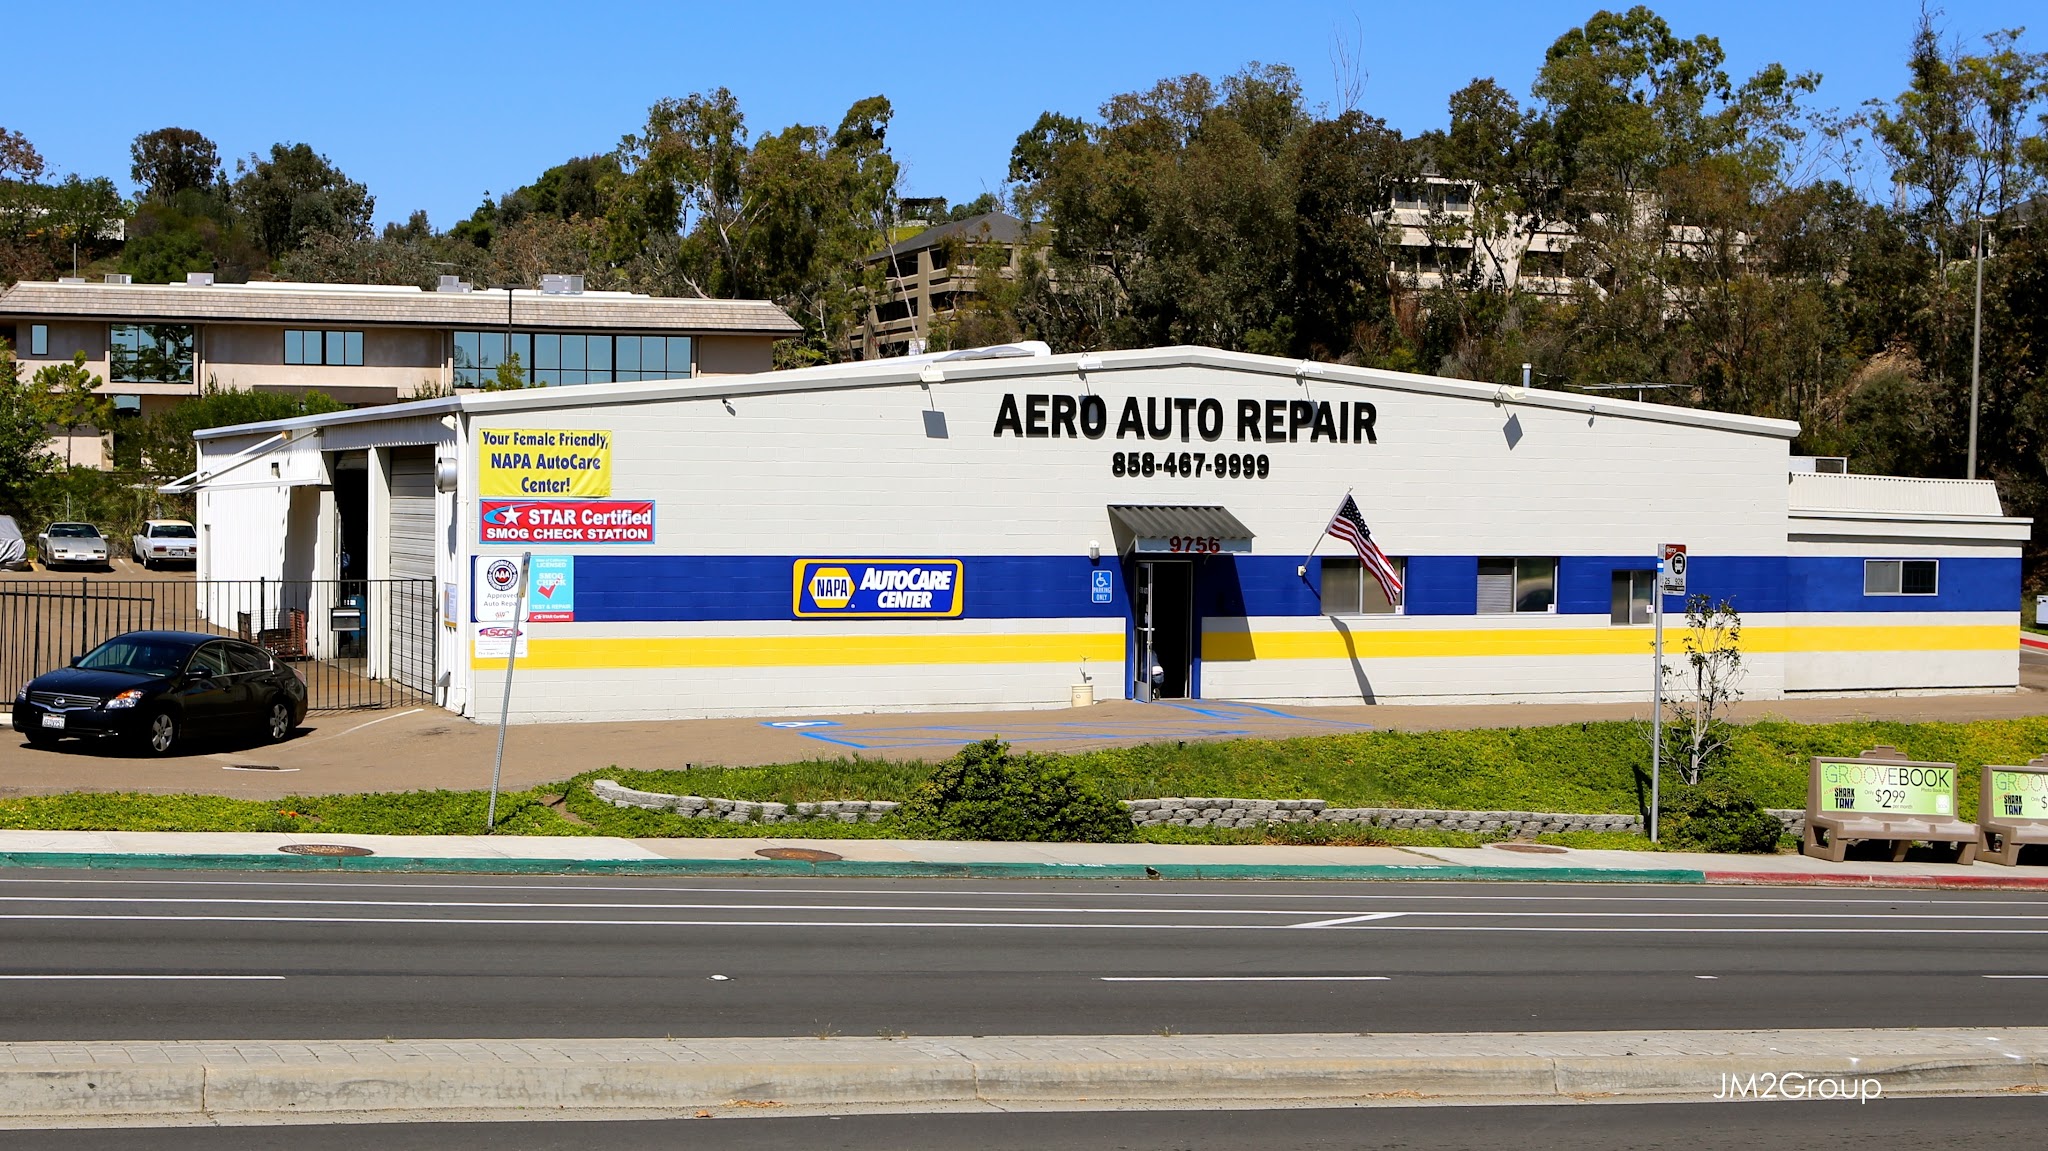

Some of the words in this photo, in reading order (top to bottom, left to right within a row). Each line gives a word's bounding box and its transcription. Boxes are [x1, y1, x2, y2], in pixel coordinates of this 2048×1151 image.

[994, 392, 1107, 440] AERO
[1116, 396, 1224, 442] AUTO
[1237, 399, 1378, 444] REPAIR
[482, 432, 510, 446] Your
[514, 432, 556, 446] Female
[559, 432, 609, 450] Friendly,
[490, 453, 532, 469] NAPA
[536, 454, 601, 470] AutoCare
[1112, 451, 1270, 480] 858-467-9999
[521, 476, 571, 494] Center!
[528, 509, 576, 526] STAR
[582, 509, 652, 526] Certified
[486, 528, 529, 540] SMOG
[533, 528, 584, 540] CHECK
[587, 528, 648, 540] STATION
[1169, 536, 1221, 554] 9756
[495, 570, 510, 578] AAA
[860, 568, 952, 590] AUTOCARE
[816, 579, 848, 597] NAPA
[878, 592, 932, 608] CENTER
[1825, 764, 1949, 788] GROOVEBOOK
[1834, 787, 1855, 798] SHARK
[2004, 795, 2022, 804] SHARK
[1835, 798, 1855, 809] TANK
[2004, 805, 2023, 815] TANK
